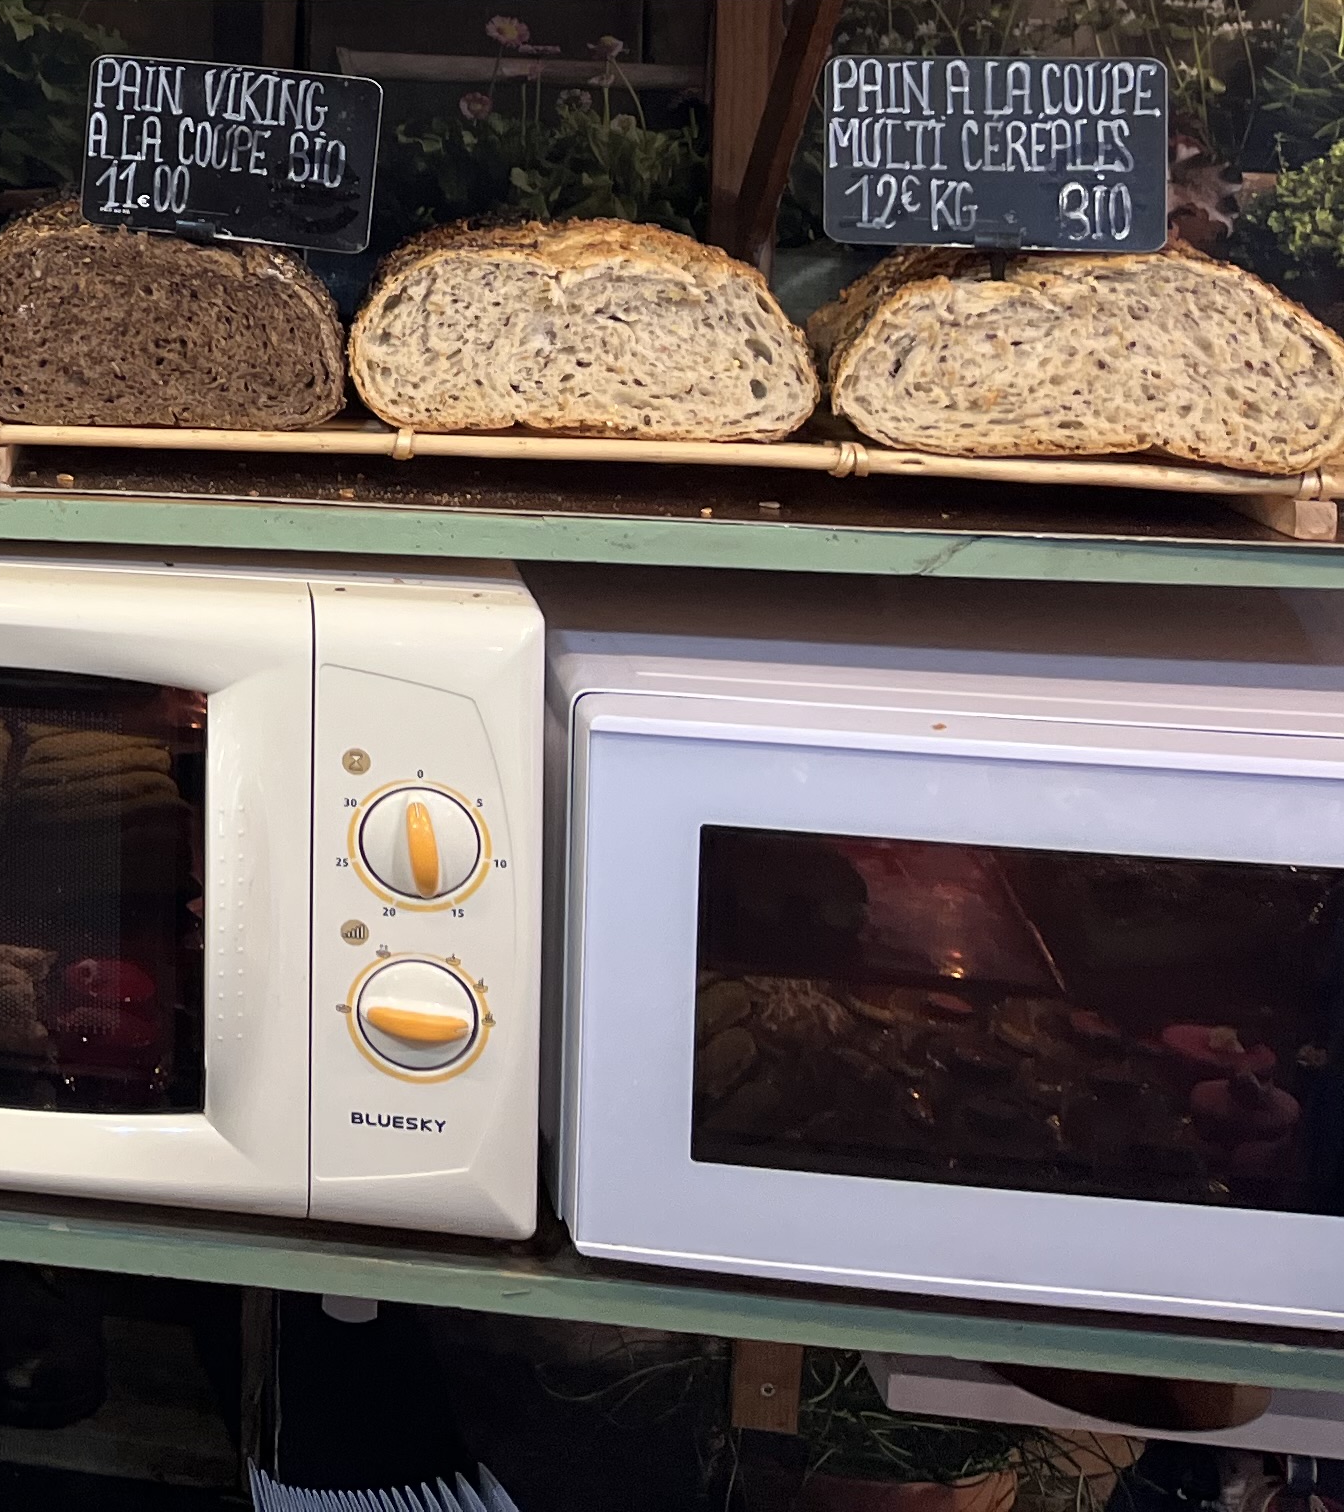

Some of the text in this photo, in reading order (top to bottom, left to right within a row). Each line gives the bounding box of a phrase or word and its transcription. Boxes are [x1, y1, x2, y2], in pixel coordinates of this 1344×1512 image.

[832, 58, 935, 115] PAIN
[984, 60, 1033, 116] LA
[1041, 61, 1162, 117] COUPE
[93, 58, 329, 132] PAIN VIKING
[828, 112, 1135, 173] MULTI CÉRÉALES
[120, 114, 164, 162] LA
[179, 116, 272, 177] COUPE
[287, 131, 347, 189] BIO
[844, 173, 1133, 241] 12€ KG BIO
[417, 769, 424, 779] 0
[343, 798, 357, 807] 30
[476, 798, 483, 807] 5
[335, 857, 349, 867] 25
[494, 859, 507, 868] 10
[382, 907, 396, 917] 20
[451, 909, 465, 918] 15
[350, 1111, 447, 1134] BLUESKY
